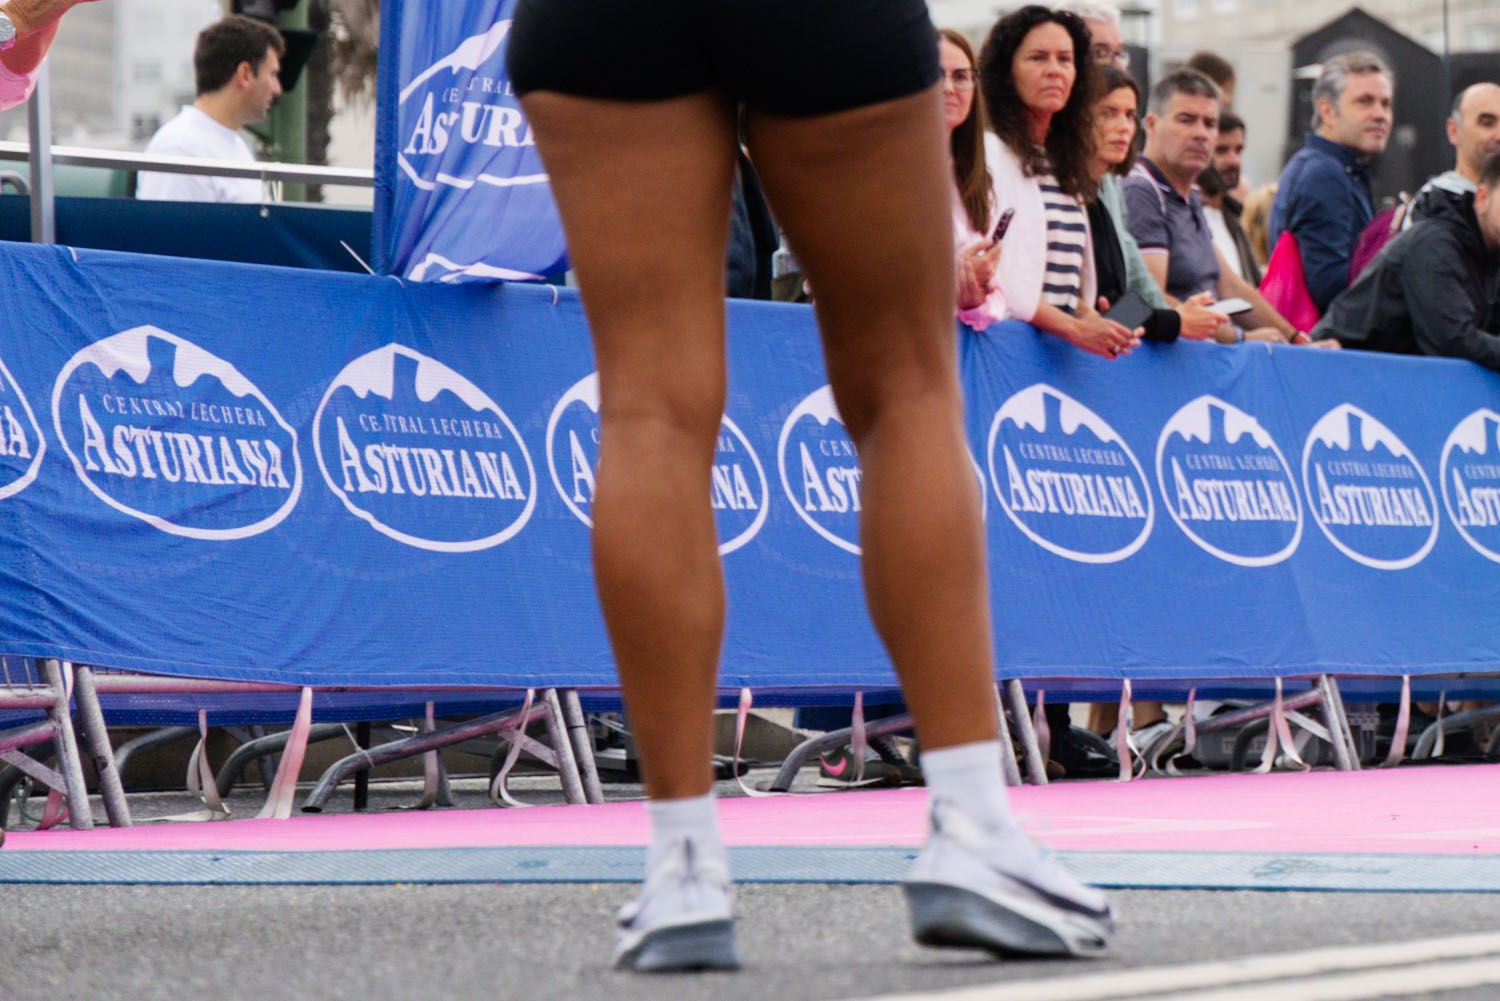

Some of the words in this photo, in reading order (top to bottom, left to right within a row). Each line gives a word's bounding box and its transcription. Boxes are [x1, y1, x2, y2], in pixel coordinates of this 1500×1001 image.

[79, 393, 291, 489] ASTURIANA
[103, 393, 186, 419] CENTRAL
[191, 401, 267, 428] LECHERA
[431, 416, 504, 440] LECHERA
[336, 416, 527, 501] ASTURIANA
[1003, 443, 1147, 519] ASTURIANA
[1019, 442, 1072, 464] CENTRAL
[1171, 455, 1298, 522] ASTURIANA
[1314, 461, 1433, 527] ASTURIANA
